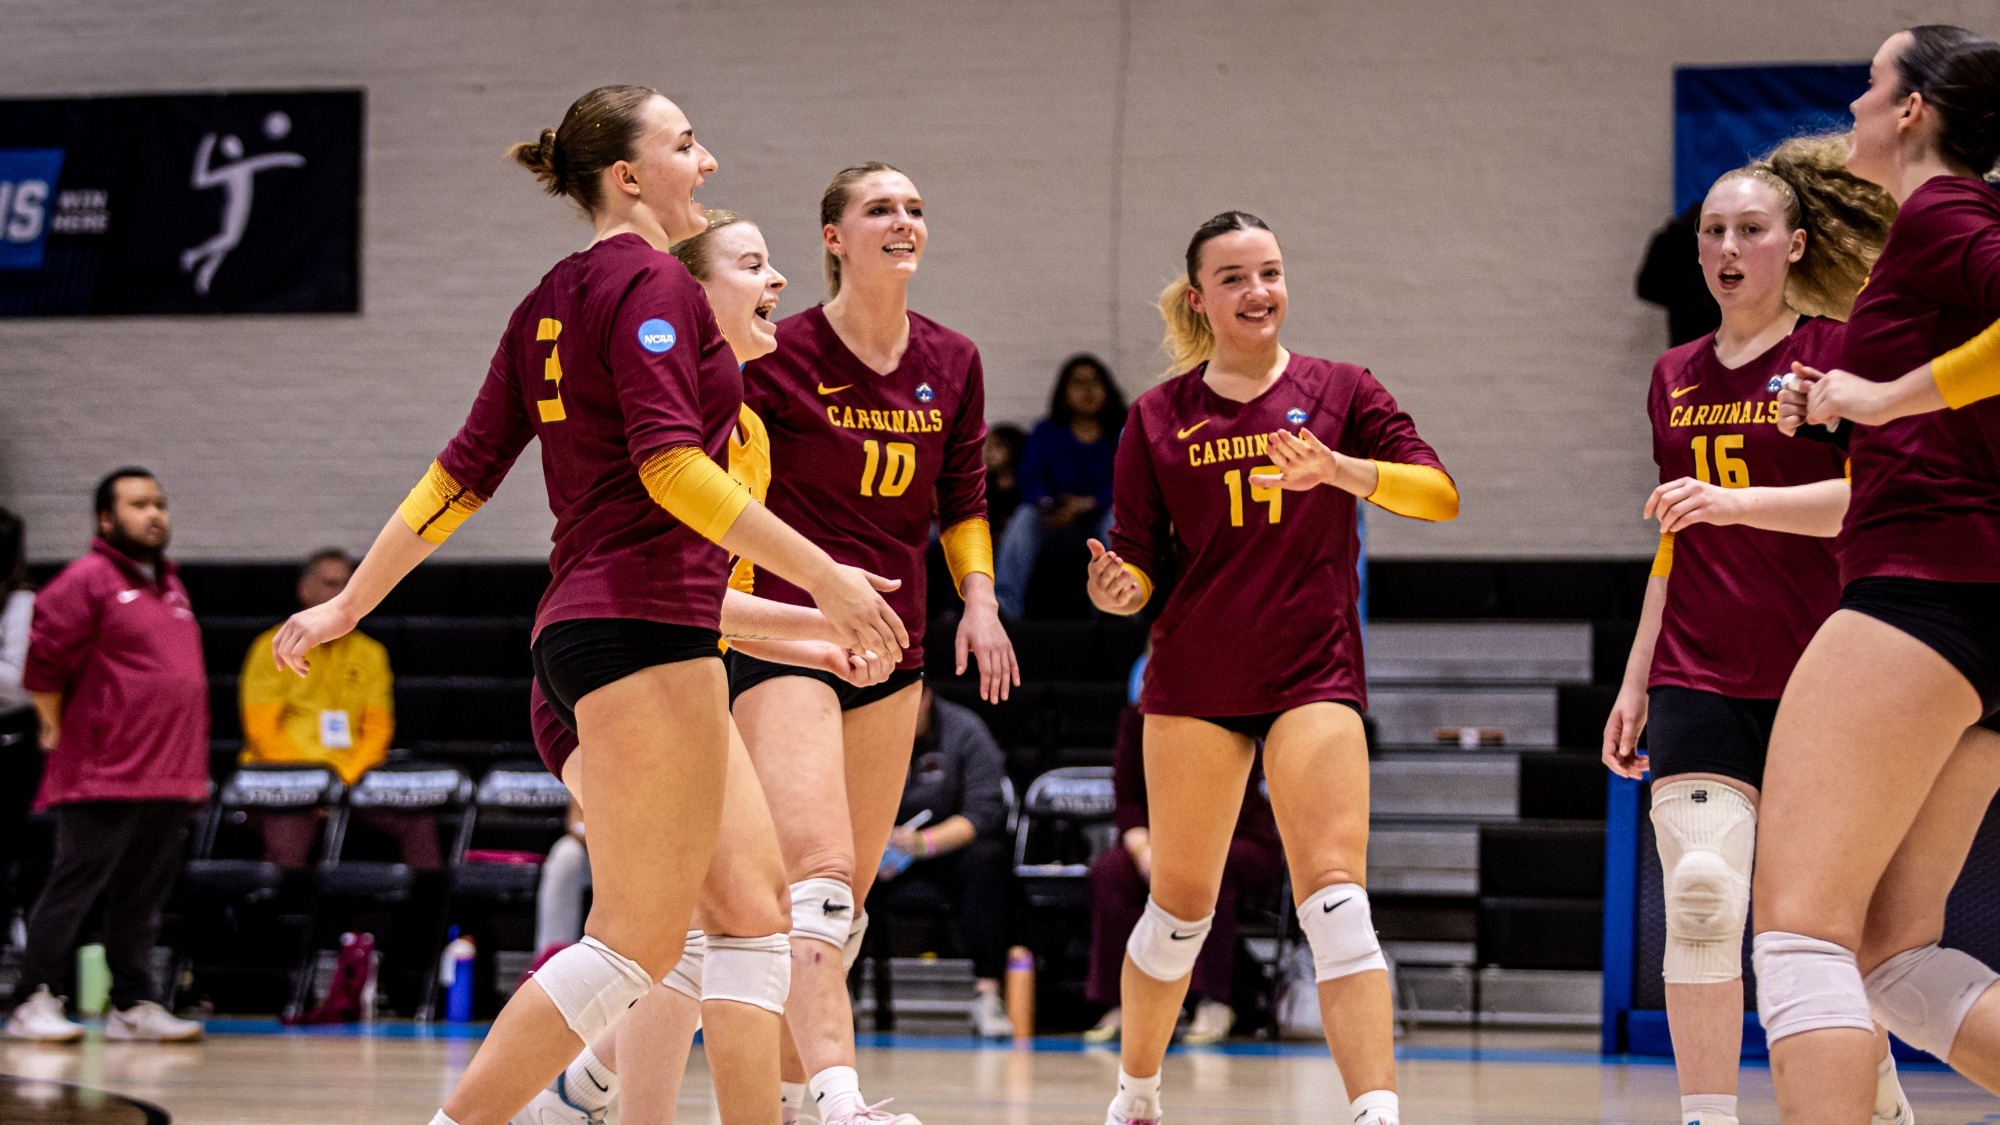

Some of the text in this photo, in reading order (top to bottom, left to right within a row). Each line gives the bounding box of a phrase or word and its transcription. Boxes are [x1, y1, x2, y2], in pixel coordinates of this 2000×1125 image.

[644, 334, 674, 345] NCAA
[536, 317, 567, 423] 3
[826, 405, 943, 433] CARDINALS
[1669, 400, 1780, 428] CARDINALS
[859, 439, 916, 497] 10
[1188, 430, 1309, 467] CARDIN
[1690, 434, 1750, 489] 16
[1223, 464, 1283, 527] 19
